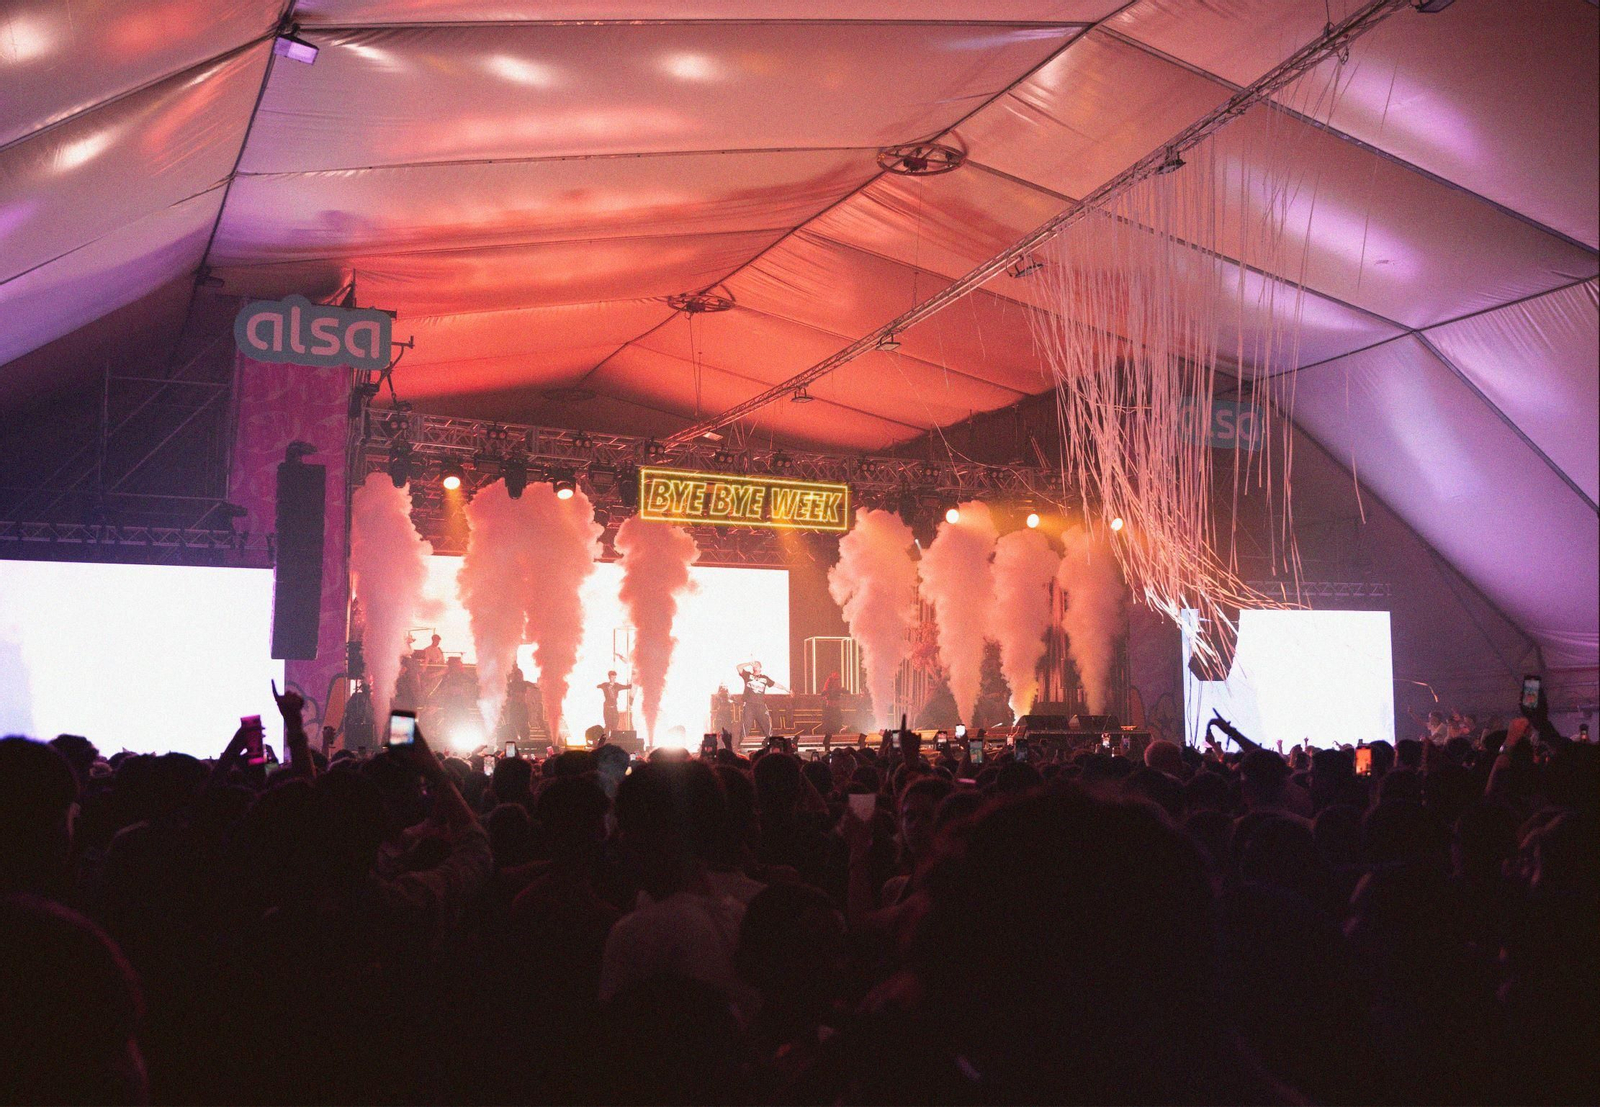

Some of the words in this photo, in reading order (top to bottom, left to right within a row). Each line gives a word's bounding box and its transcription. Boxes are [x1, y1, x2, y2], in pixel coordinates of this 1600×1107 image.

[246, 306, 381, 360] alsa
[1179, 403, 1261, 442] asa
[647, 478, 707, 515] BYE
[709, 483, 766, 518] BYE
[770, 487, 842, 523] WEEK
